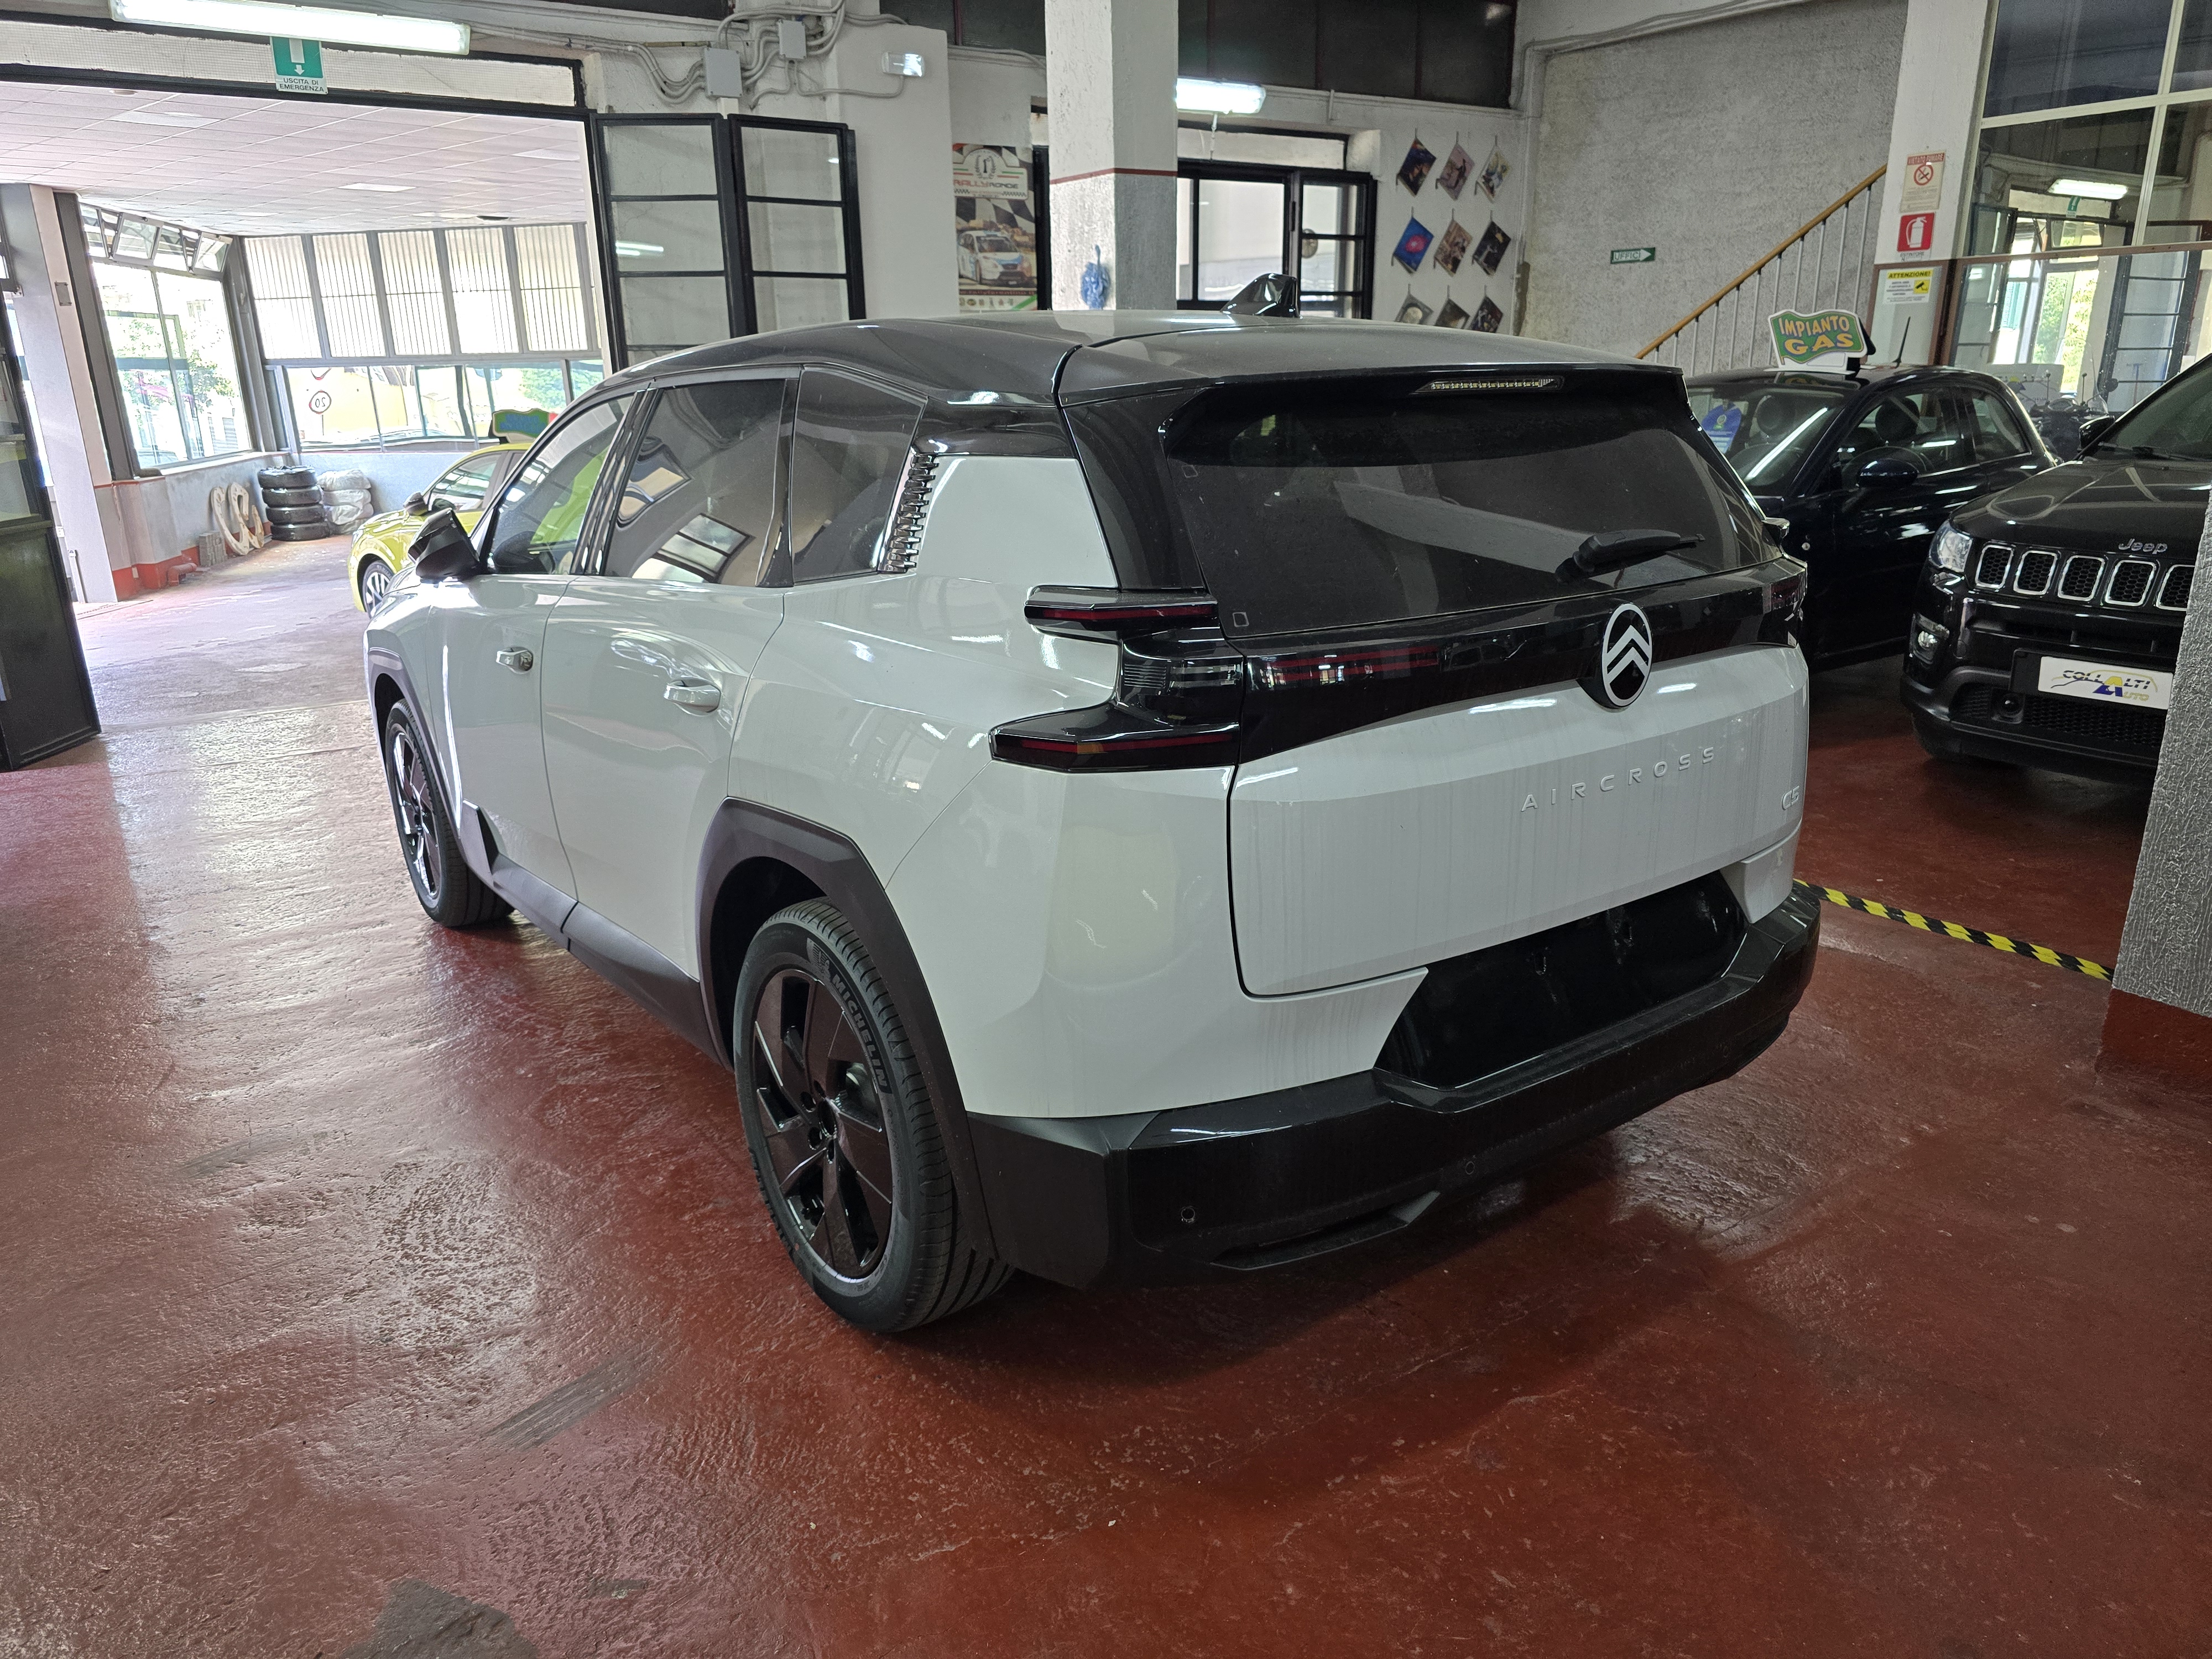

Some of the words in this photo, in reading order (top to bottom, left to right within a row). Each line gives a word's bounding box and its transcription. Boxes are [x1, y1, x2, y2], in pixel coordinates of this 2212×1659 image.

[279, 84, 324, 92] EMERGENZA
[1614, 251, 1641, 260] UFFICI
[1778, 315, 1850, 337] IMPIANTO
[1784, 332, 1854, 356] GAS
[2118, 538, 2168, 555] Jeep
[1521, 747, 1715, 812] AIRCROSS
[1782, 785, 1800, 811] C5
[832, 974, 888, 1088] MICHELIN
